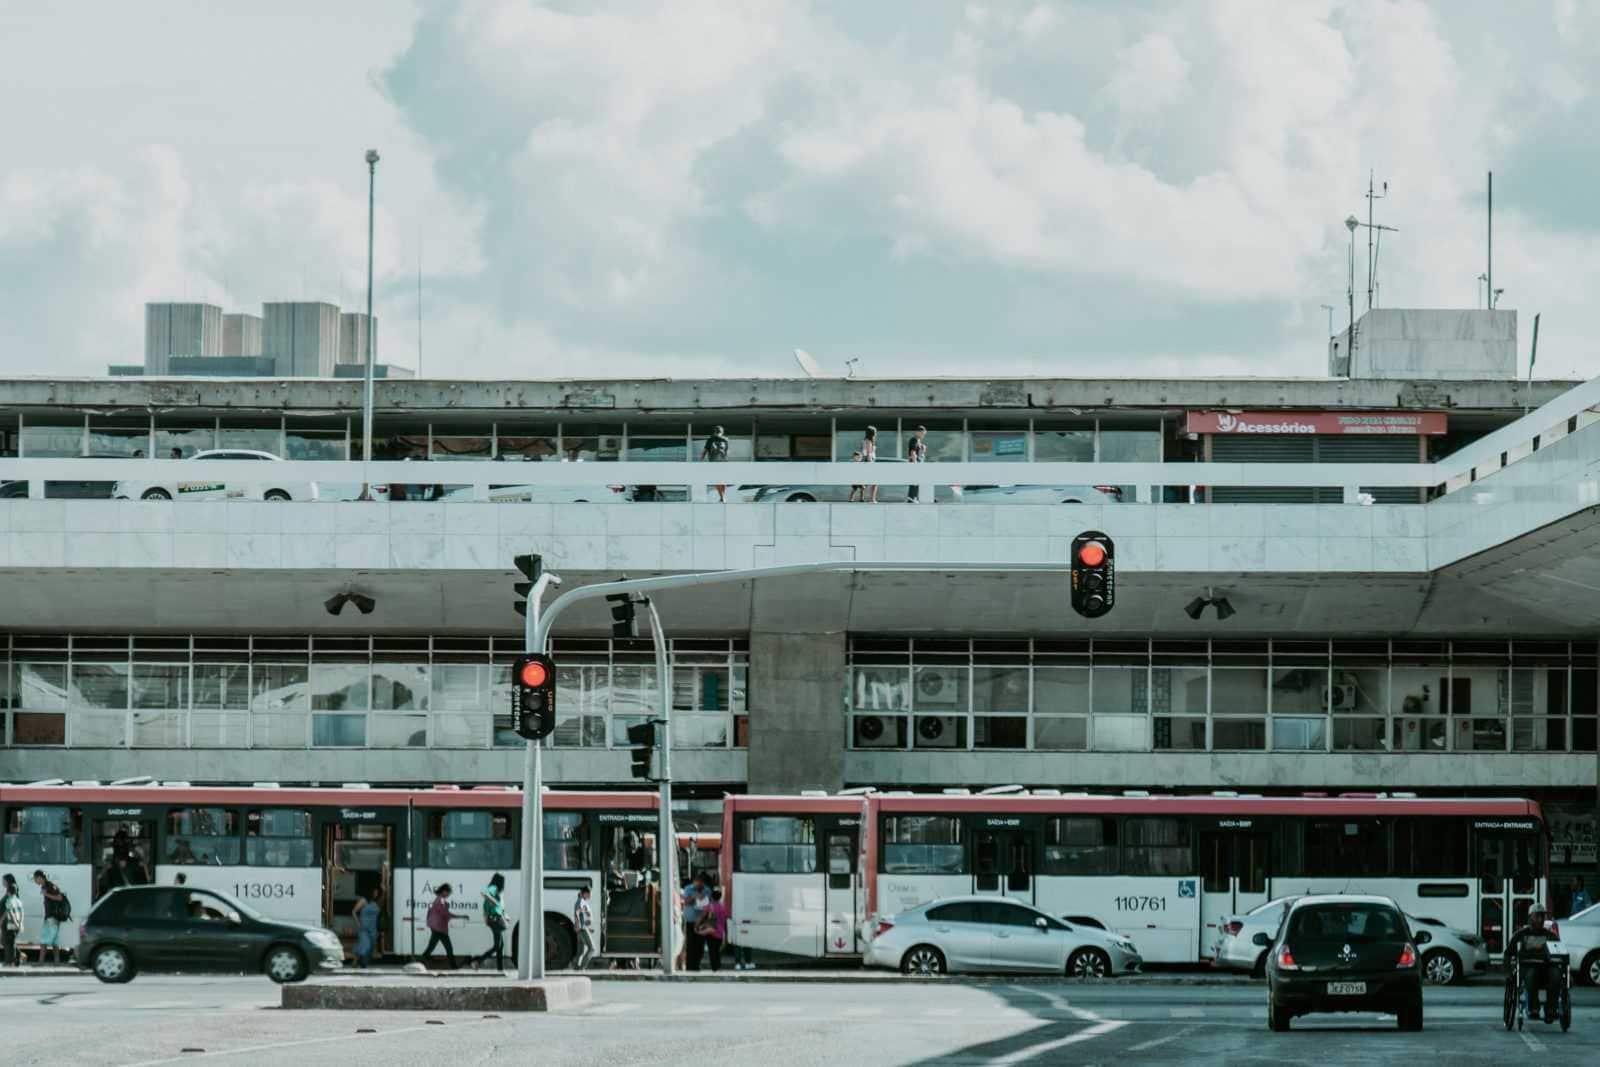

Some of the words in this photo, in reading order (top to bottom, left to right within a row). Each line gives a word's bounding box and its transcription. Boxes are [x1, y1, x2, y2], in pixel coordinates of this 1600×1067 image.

[1237, 422, 1316, 433] Acessórios
[232, 882, 296, 899] 113034
[1114, 896, 1167, 912] 110761
